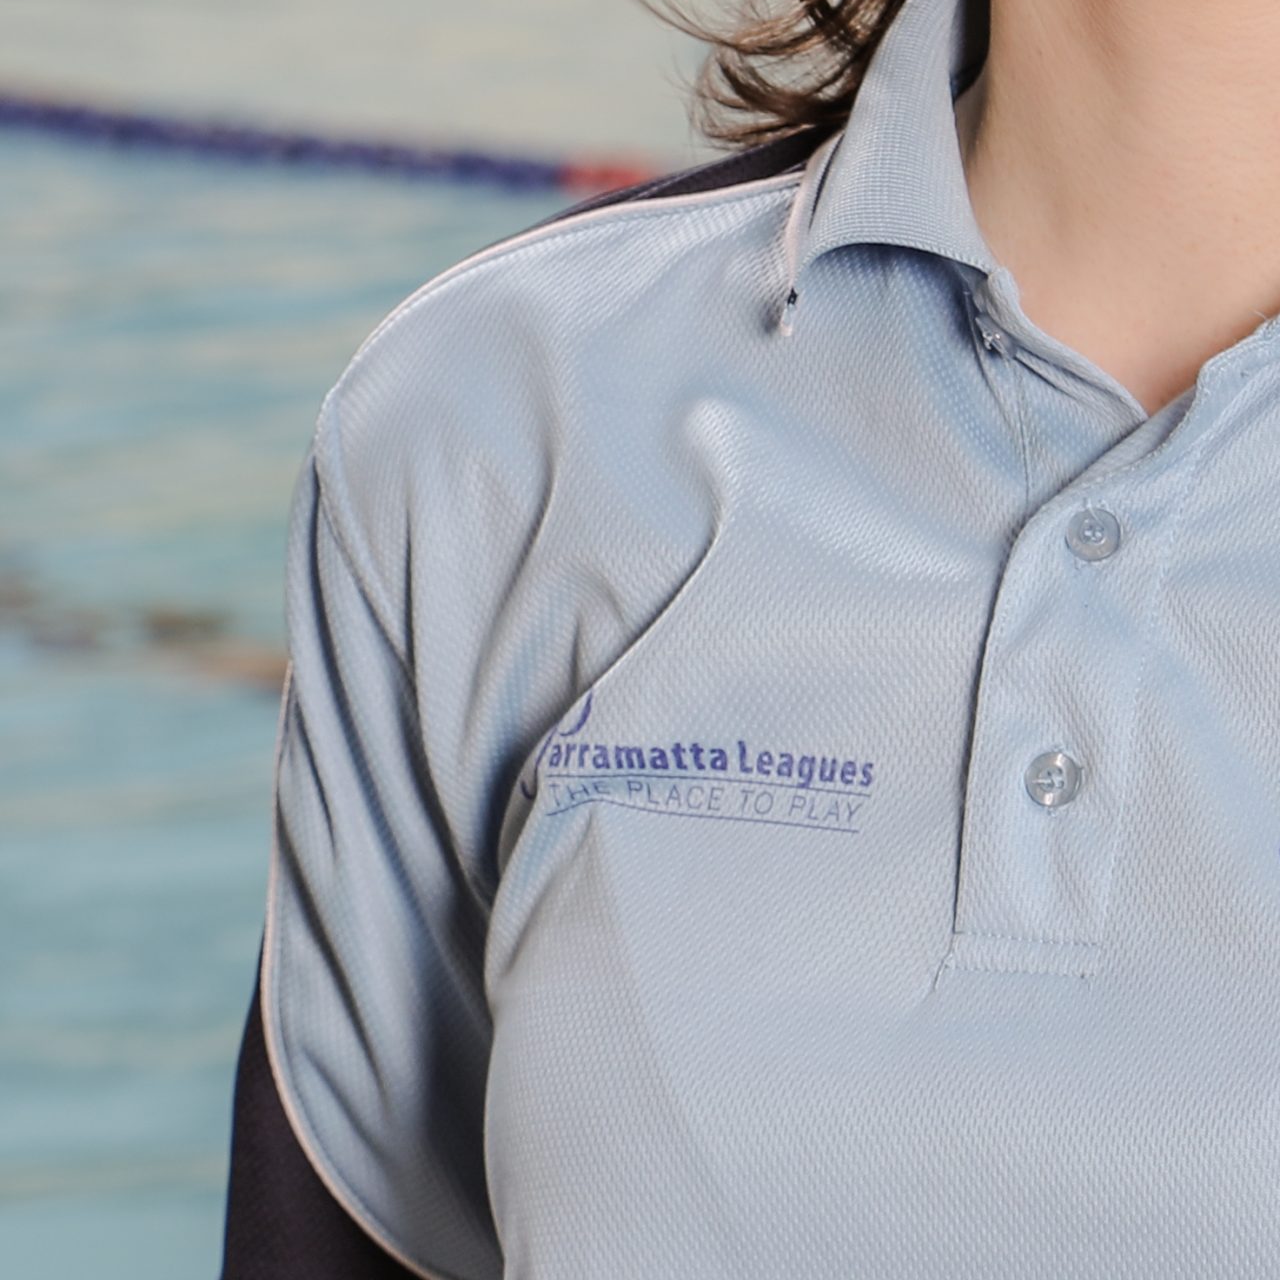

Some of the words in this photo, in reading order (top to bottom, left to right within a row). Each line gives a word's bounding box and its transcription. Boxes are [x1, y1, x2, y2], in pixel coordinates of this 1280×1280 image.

[737, 740, 874, 789] Leagues
[548, 780, 611, 807] THE
[627, 779, 725, 811] PLACE
[740, 789, 774, 815] TO
[788, 794, 862, 822] PLAY
